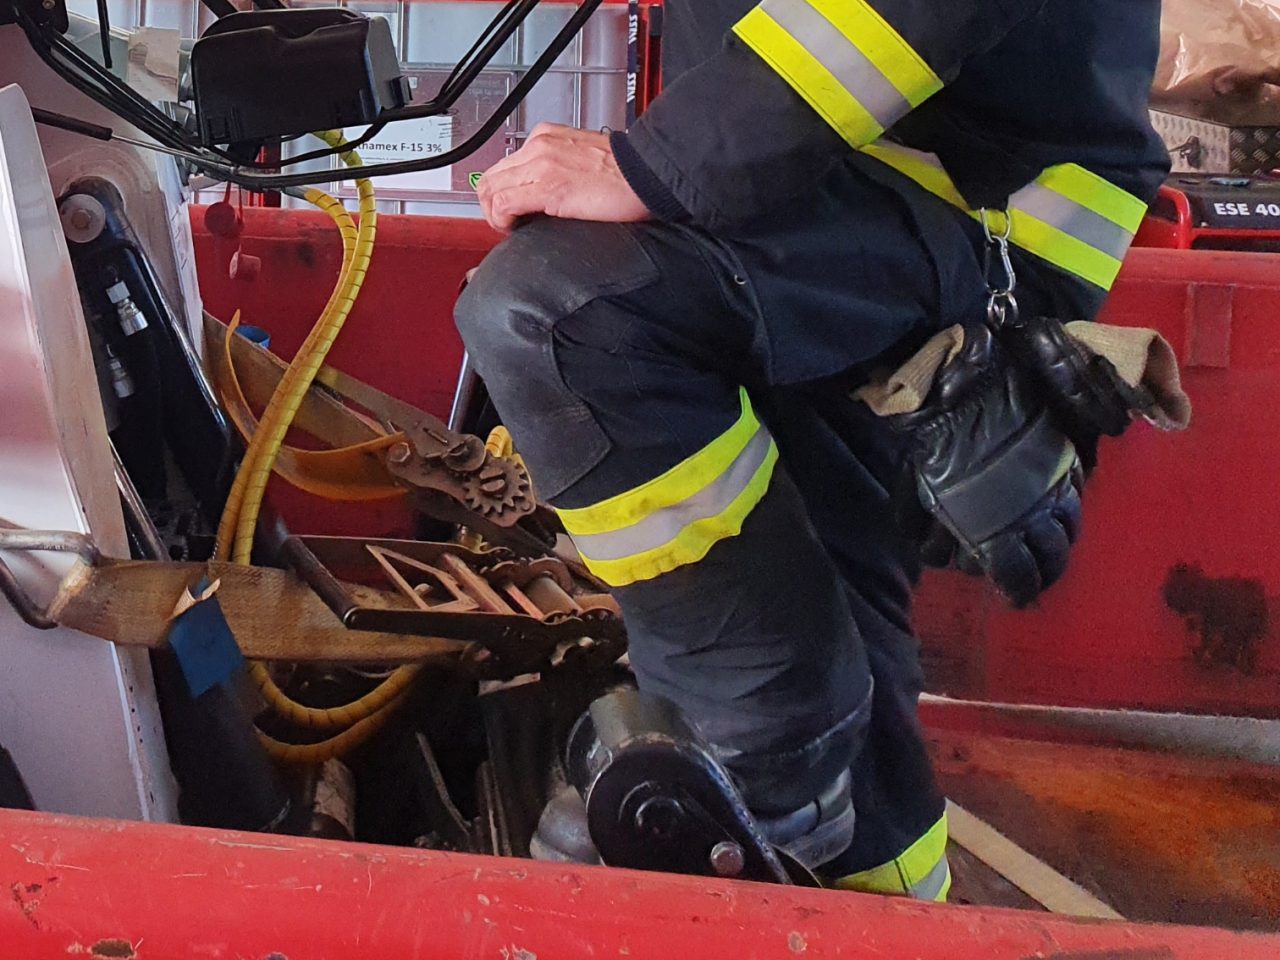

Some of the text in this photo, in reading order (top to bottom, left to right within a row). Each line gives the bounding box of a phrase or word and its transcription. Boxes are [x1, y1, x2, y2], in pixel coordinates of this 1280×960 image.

[400, 142, 423, 152] F-15
[426, 143, 442, 153] 3%
[1213, 202, 1250, 216] ESE
